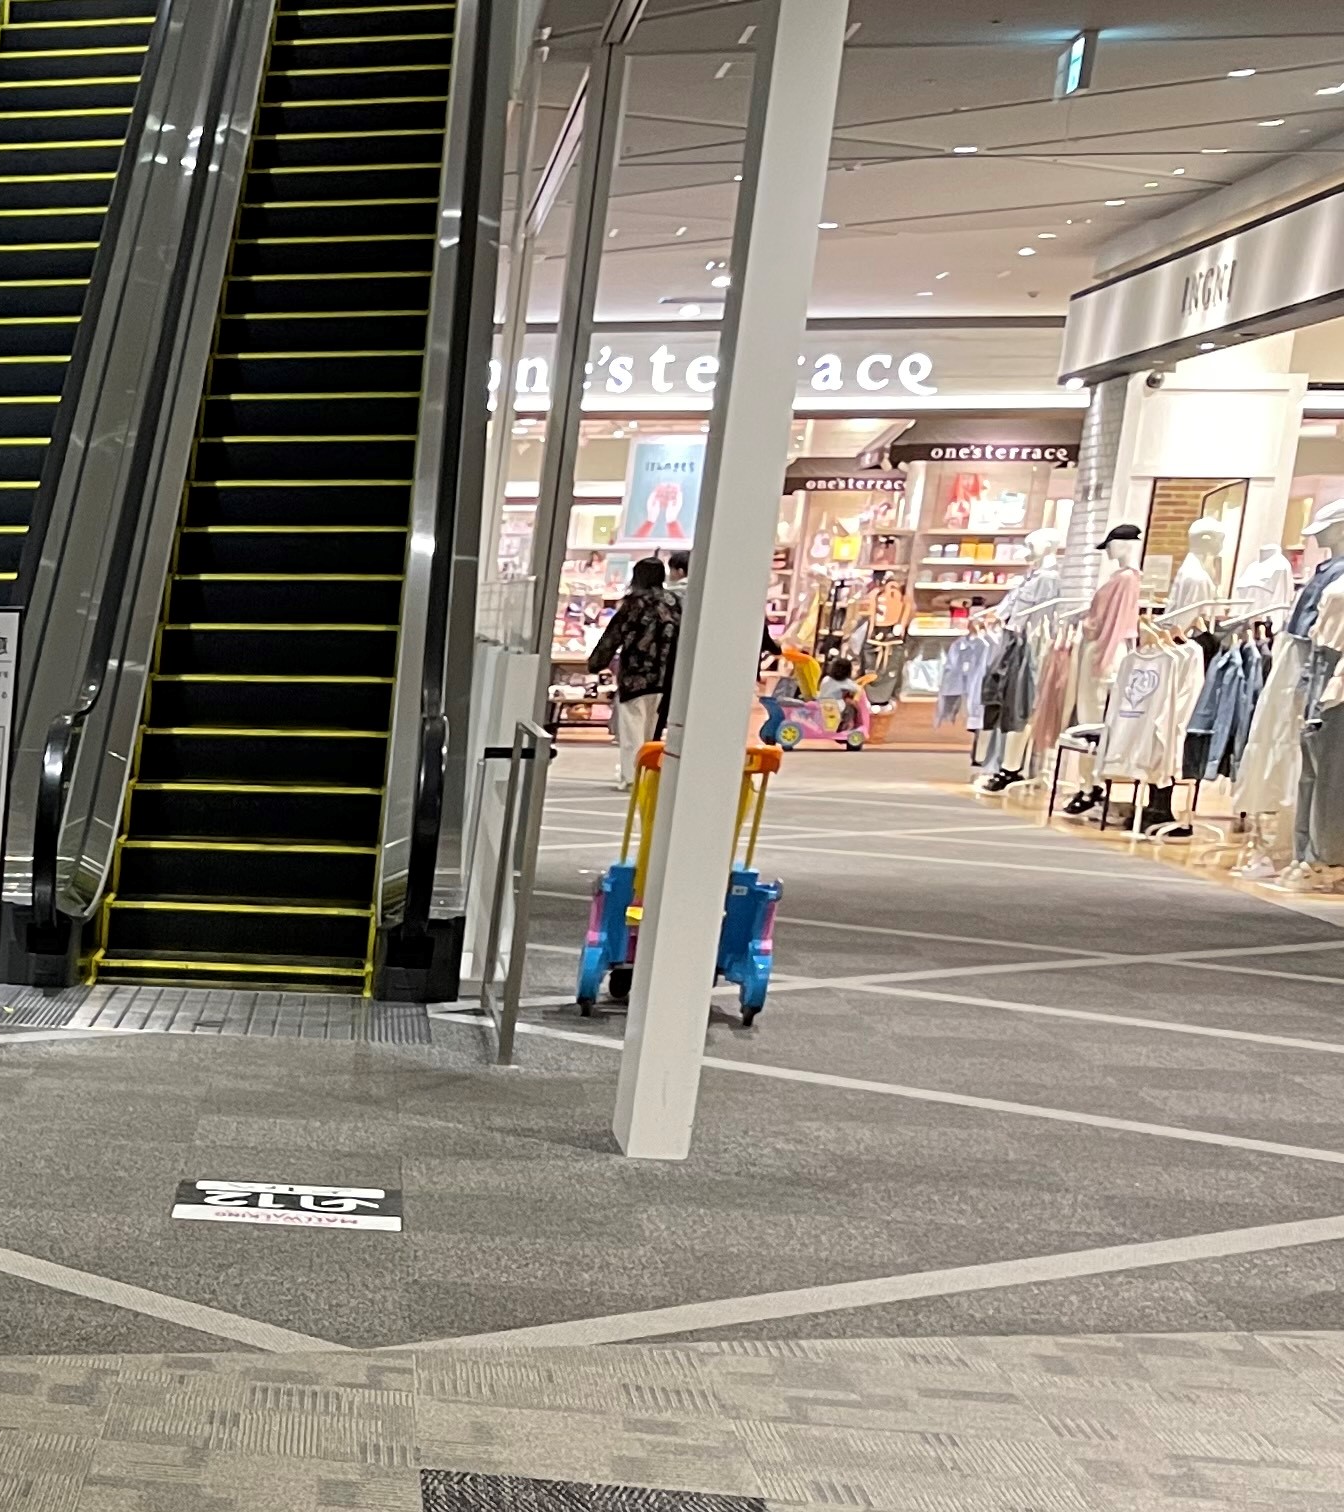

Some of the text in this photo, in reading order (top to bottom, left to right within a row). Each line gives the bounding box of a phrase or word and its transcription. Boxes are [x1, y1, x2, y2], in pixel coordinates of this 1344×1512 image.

[1181, 260, 1237, 316] INGNI
[487, 345, 938, 395] n's teace
[848, 478, 905, 490] terrac
